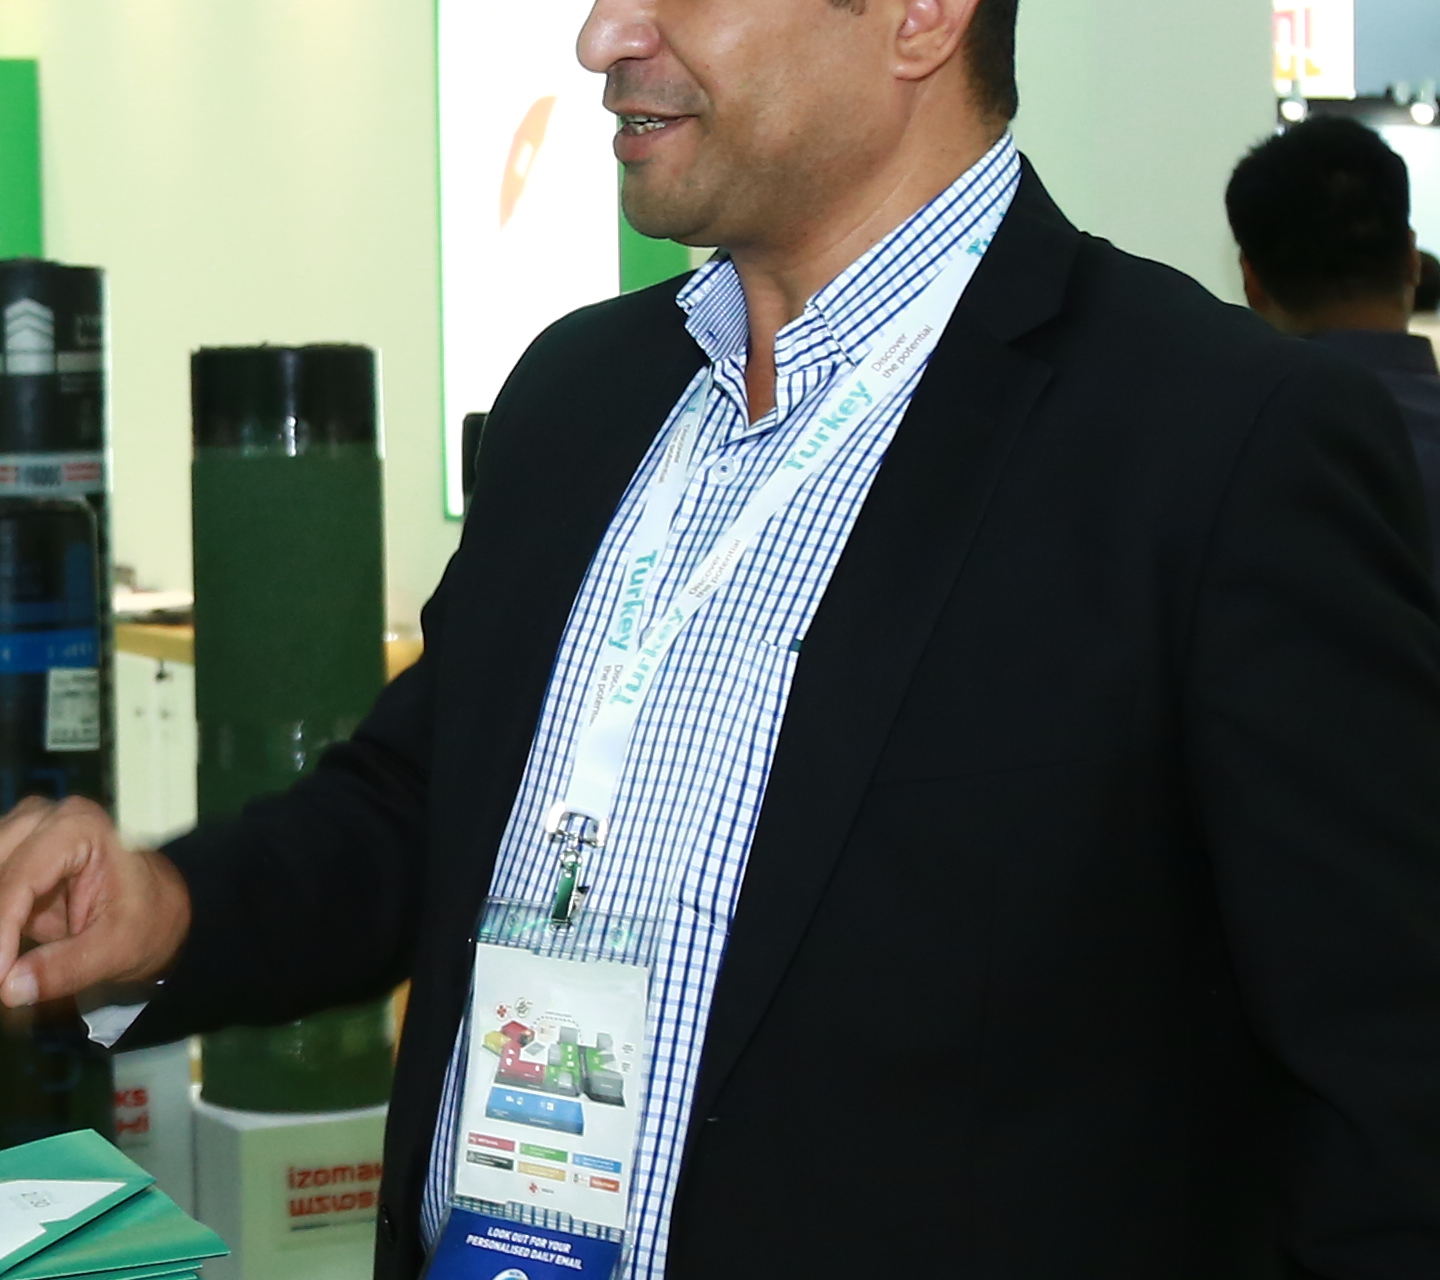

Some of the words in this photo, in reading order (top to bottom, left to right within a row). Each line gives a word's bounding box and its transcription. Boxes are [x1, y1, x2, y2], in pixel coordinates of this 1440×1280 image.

[870, 331, 909, 373] Discover
[881, 361, 899, 379] the
[896, 323, 935, 366] potential
[784, 379, 874, 471] Turkey
[609, 548, 658, 652] Turkey
[465, 1234, 531, 1258] PERSONALISED
[530, 1249, 556, 1263] DAILY
[486, 1226, 512, 1241] LOOK
[511, 1231, 530, 1245] OUT
[529, 1235, 548, 1250] FOR
[548, 1239, 572, 1254] YOUR
